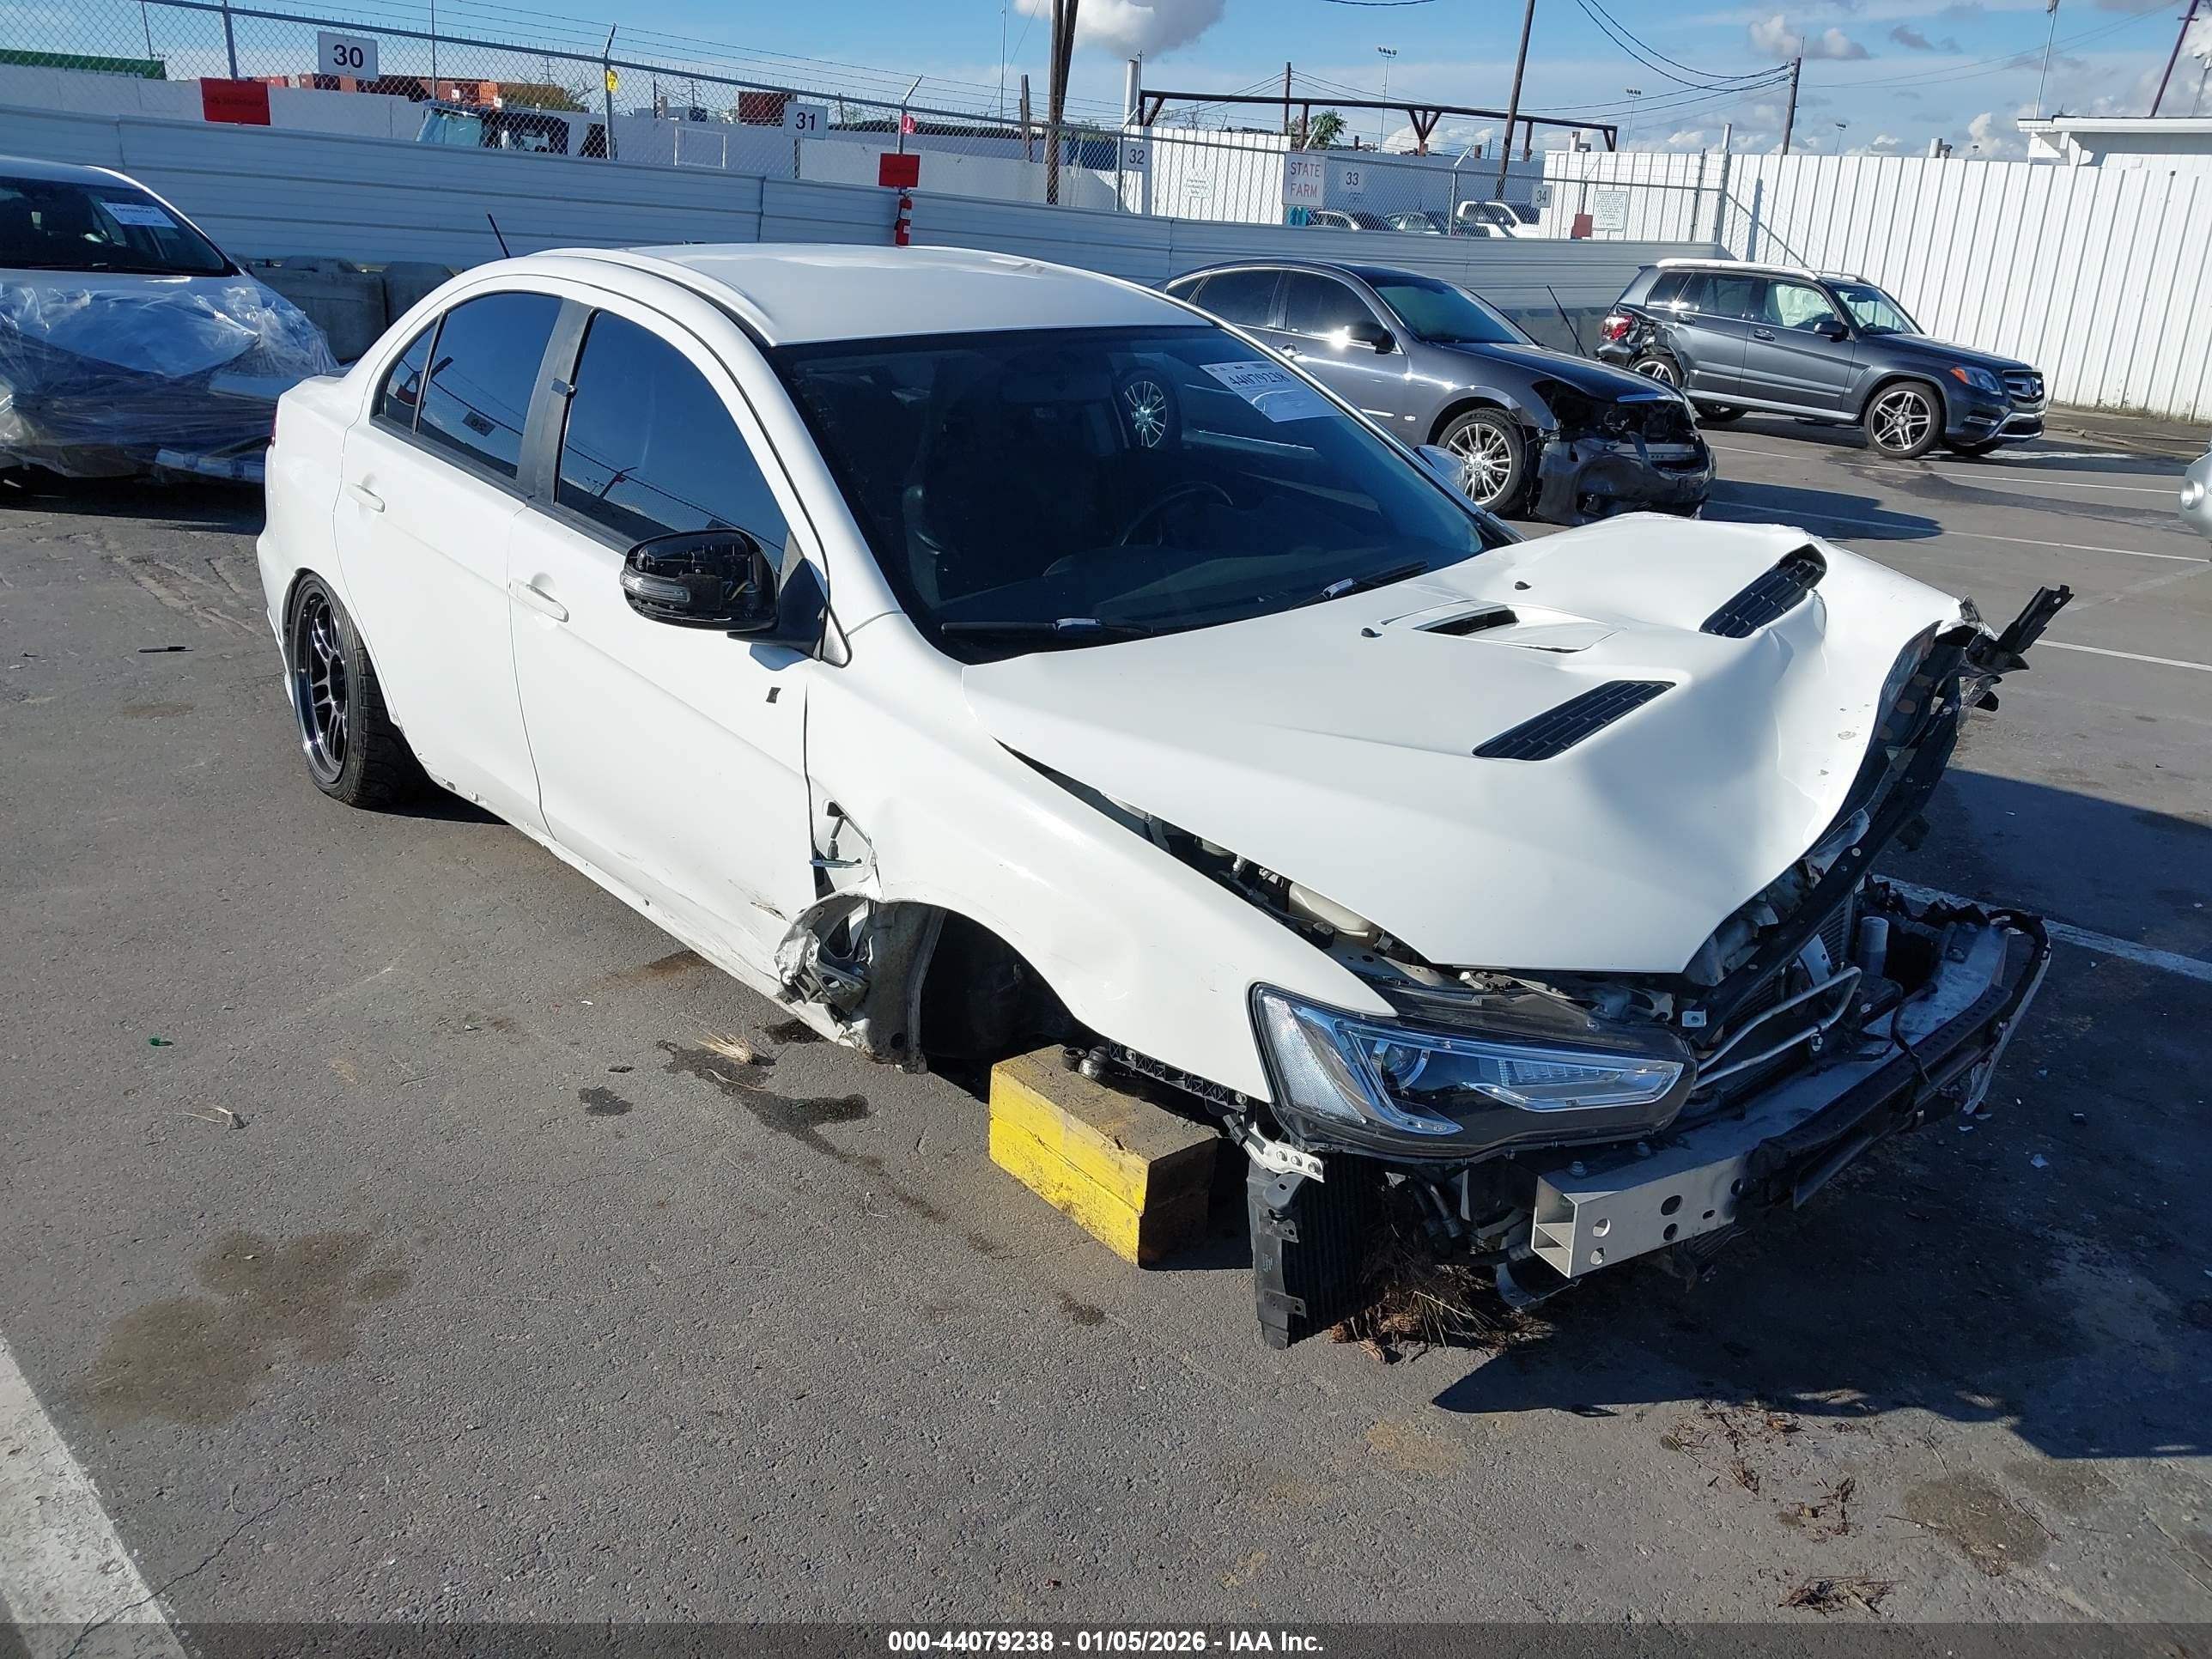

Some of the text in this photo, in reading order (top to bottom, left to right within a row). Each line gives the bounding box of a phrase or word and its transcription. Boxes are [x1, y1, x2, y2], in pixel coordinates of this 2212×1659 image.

[333, 44, 364, 69] 30
[795, 112, 817, 131] 31
[1128, 148, 1146, 165] 32
[1290, 161, 1321, 178] STATE
[1346, 171, 1359, 186] 33
[1290, 182, 1318, 198] FARM
[1536, 189, 1547, 203] 34
[1228, 372, 1291, 386] 44079238
